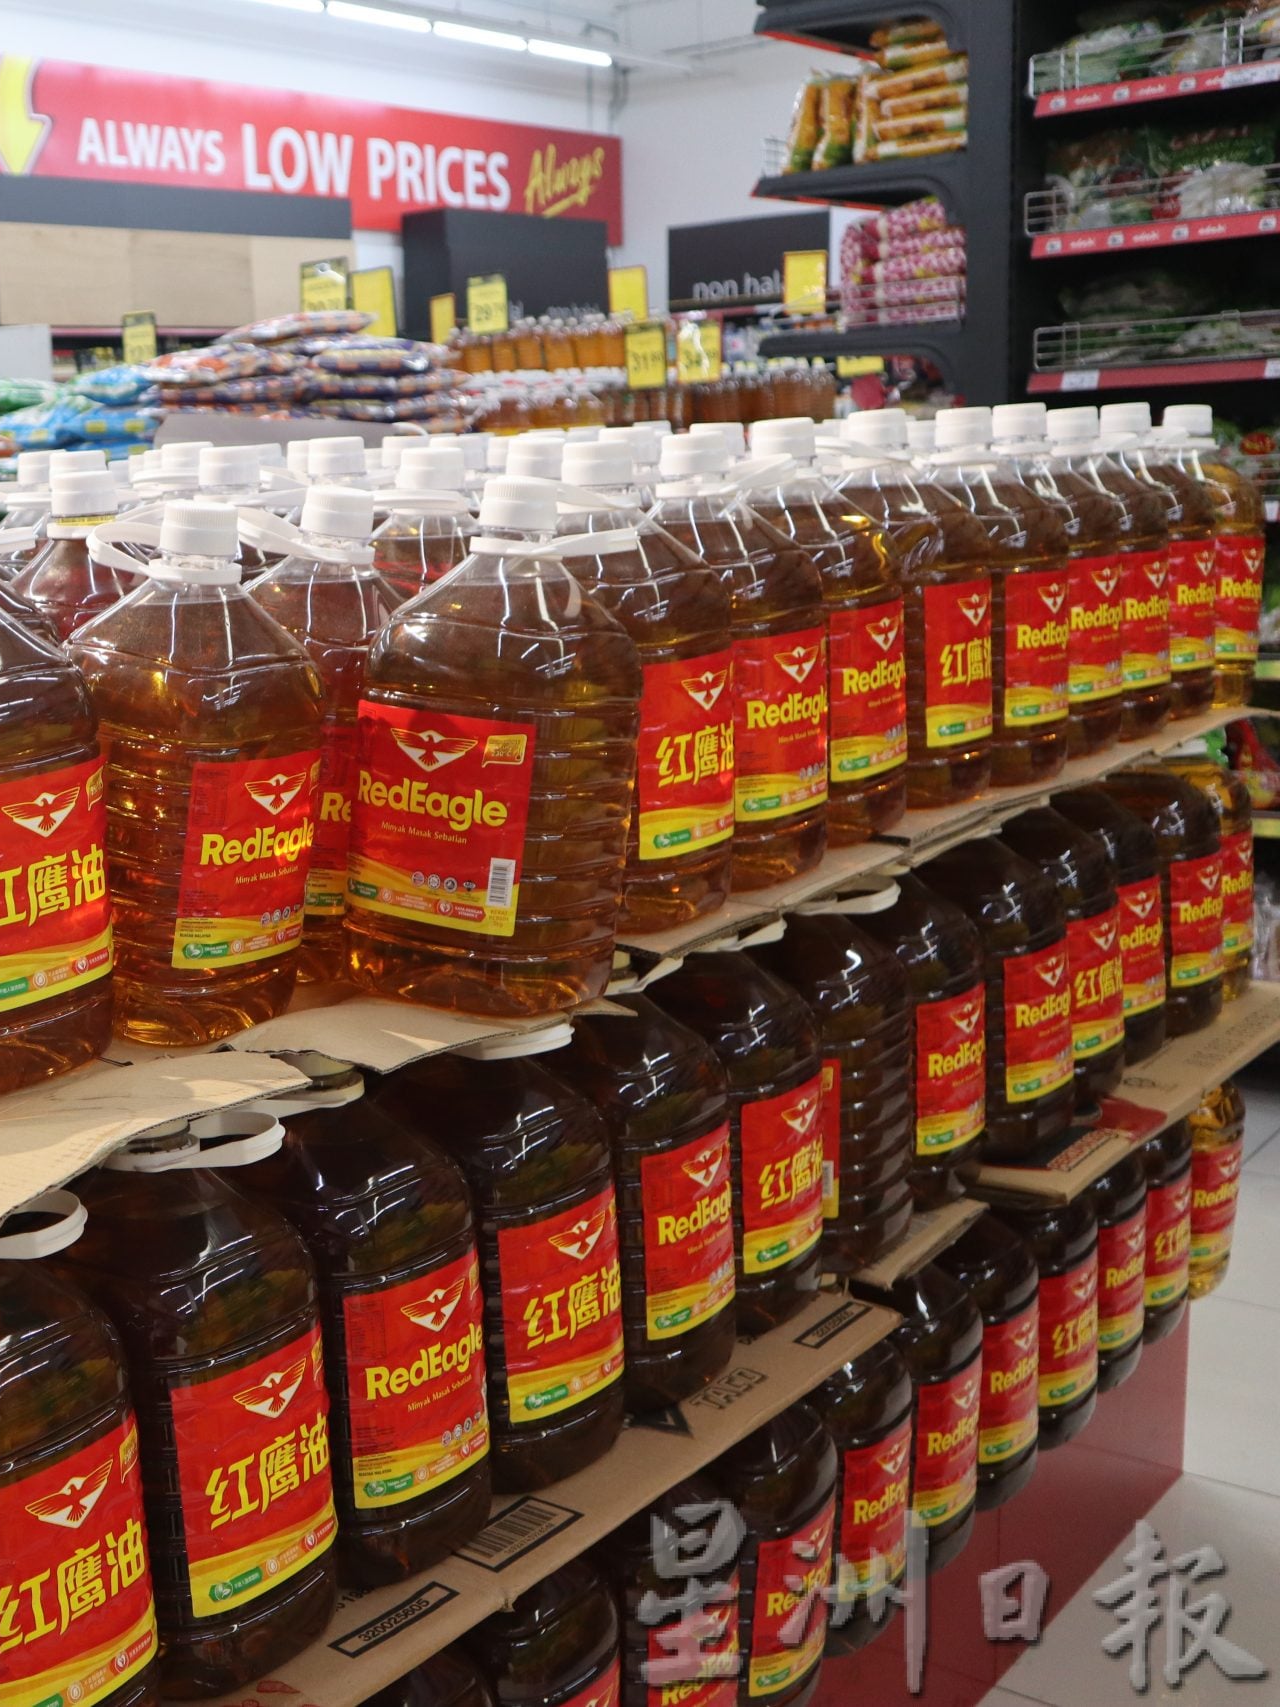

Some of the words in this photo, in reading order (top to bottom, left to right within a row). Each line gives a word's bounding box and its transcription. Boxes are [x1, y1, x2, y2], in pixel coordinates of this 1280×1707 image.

[77, 117, 225, 175] ALWAYS
[242, 123, 354, 198] LOW
[366, 137, 511, 212] PRICES
[524, 143, 605, 214] Always
[692, 278, 739, 300] non
[743, 268, 784, 297] hal
[1125, 592, 1170, 621] RedEag
[843, 656, 907, 696] RedEagl
[746, 684, 829, 730] RedEagl
[360, 770, 508, 832] RedEagle
[200, 818, 314, 866] RedEagle
[381, 821, 406, 834] Minyak
[408, 826, 432, 839] Masak
[433, 831, 467, 844] Sebatian
[235, 873, 258, 887] Minyak
[259, 870, 277, 880] Masak
[928, 1037, 986, 1078] RedEag
[523, 1259, 624, 1352] 红鹰油
[365, 1323, 483, 1400] RedEagle
[406, 1396, 431, 1413] Minyak
[432, 1387, 451, 1401] Masak
[205, 1412, 330, 1531] 红鹰油
